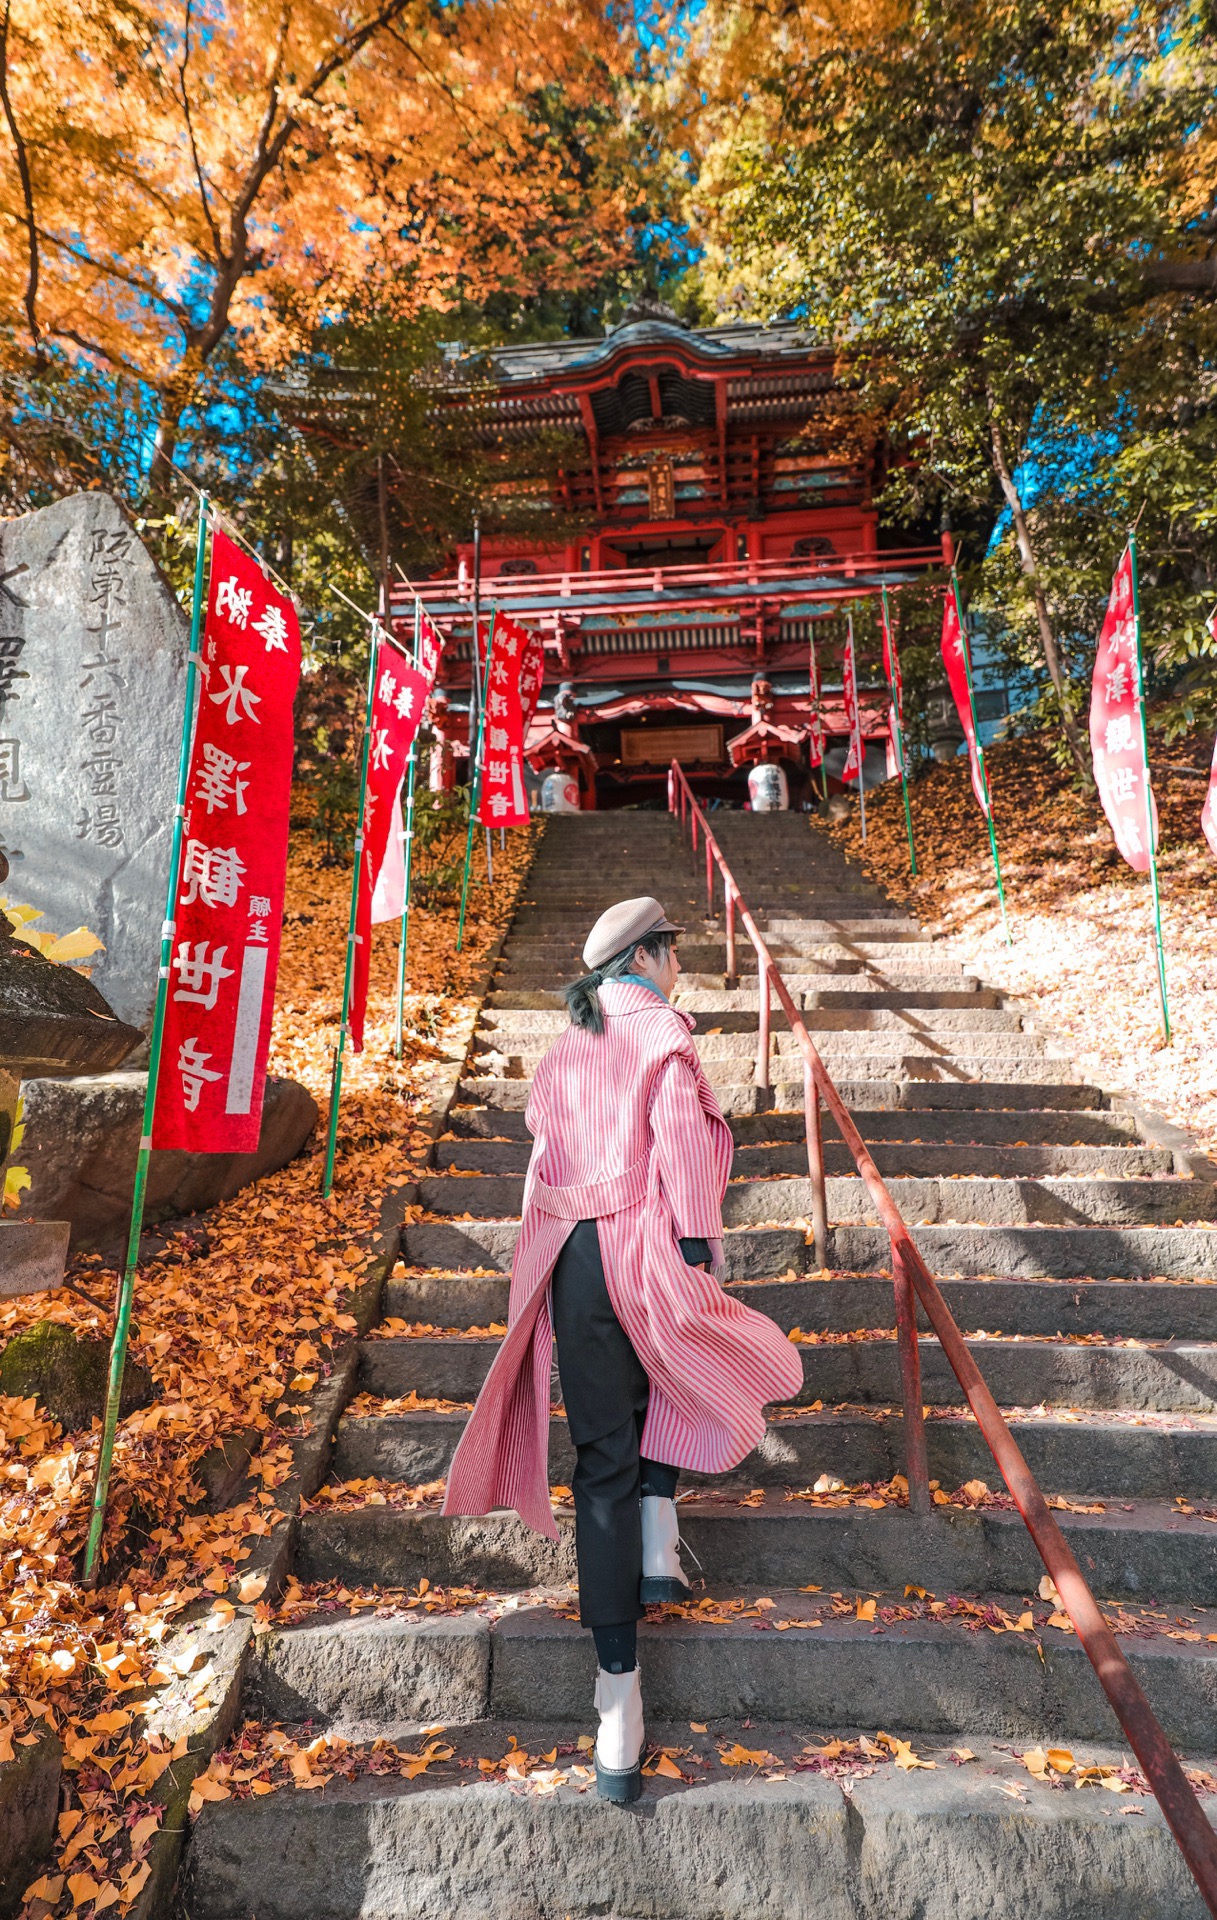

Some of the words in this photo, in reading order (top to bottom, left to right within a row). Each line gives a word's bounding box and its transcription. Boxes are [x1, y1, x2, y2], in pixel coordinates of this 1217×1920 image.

[75, 528, 135, 847] 阪東十六番霊場
